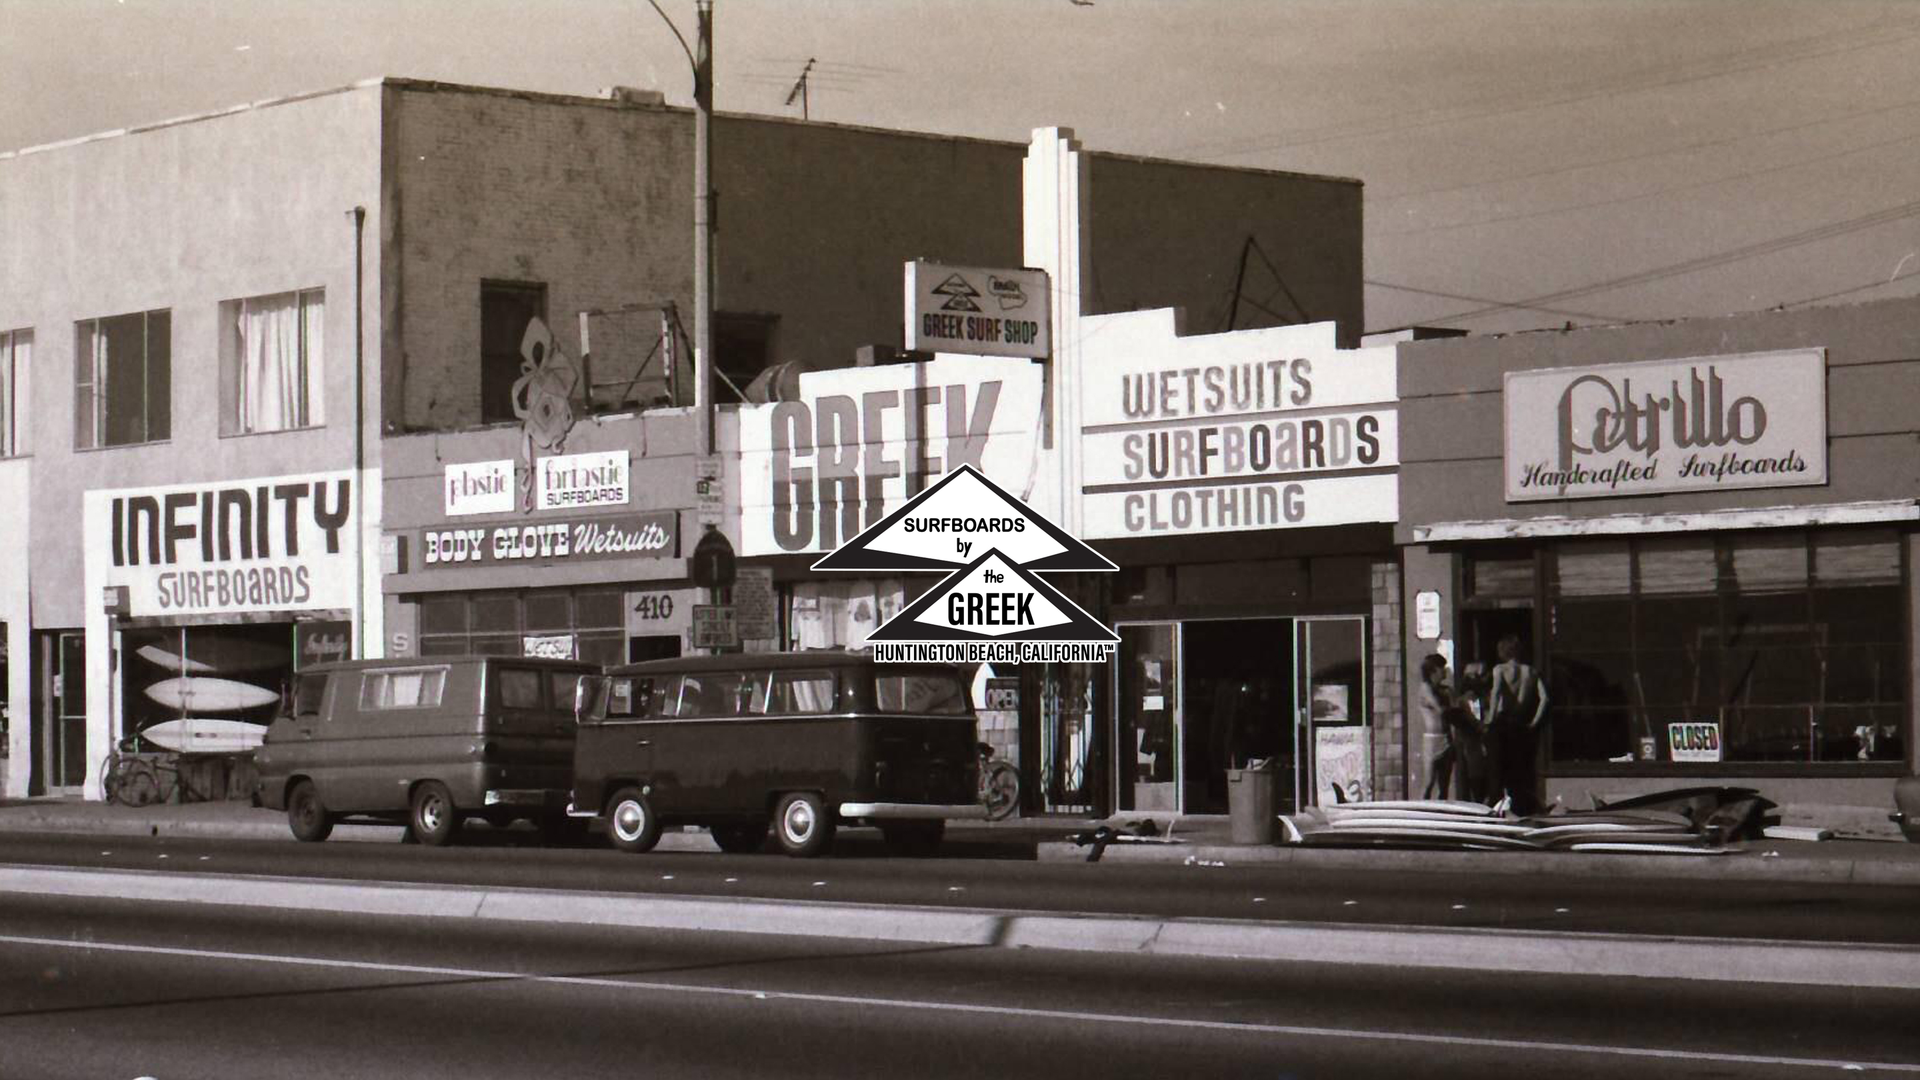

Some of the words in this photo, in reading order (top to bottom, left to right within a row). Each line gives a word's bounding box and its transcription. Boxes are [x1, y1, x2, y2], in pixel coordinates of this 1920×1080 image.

[923, 313, 964, 339] GREEK
[967, 316, 1001, 342] SURF
[1004, 319, 1038, 345] SHOP
[1122, 358, 1312, 419] WETSUITS
[1558, 365, 1767, 495] Petrillo
[1520, 458, 1659, 488] Handcrafted
[1678, 449, 1809, 482] Surfboards
[546, 487, 624, 506] SURFBOARDS
[1124, 483, 1306, 532] CLOTHING
[112, 479, 351, 567] INFINITY
[425, 528, 485, 563] BODY
[493, 523, 569, 559] GLOVE
[573, 522, 670, 555] Wetsuits
[634, 594, 674, 620] 410
[1672, 725, 1718, 751] CLOSED
